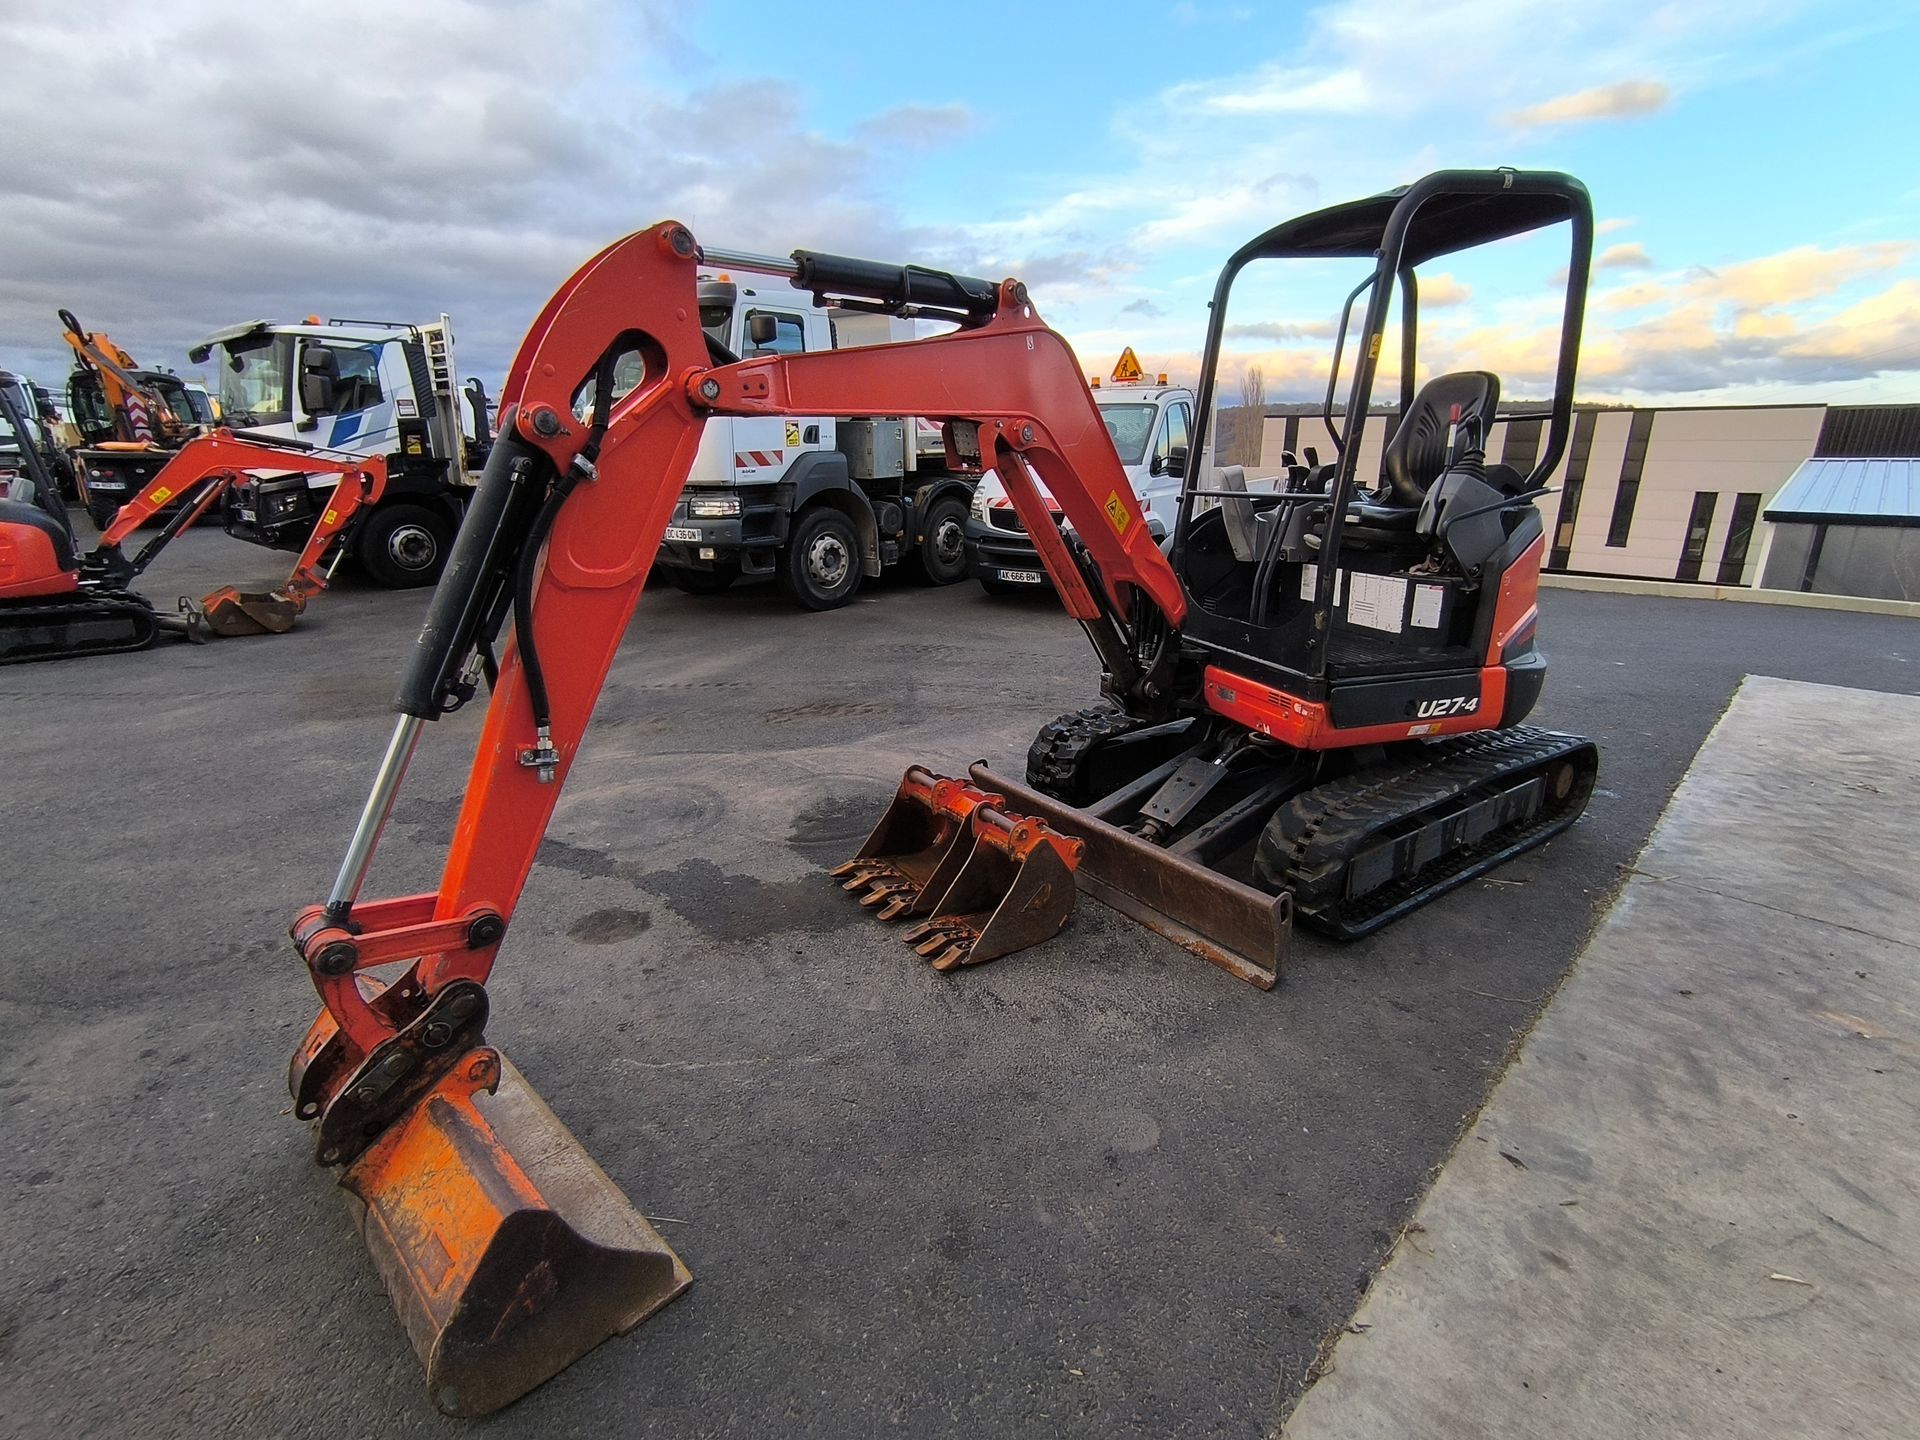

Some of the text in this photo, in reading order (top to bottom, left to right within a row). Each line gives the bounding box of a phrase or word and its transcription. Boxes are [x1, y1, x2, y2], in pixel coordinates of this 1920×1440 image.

[676, 530, 687, 539] 436
[1011, 571, 1024, 580] 666
[1417, 696, 1479, 718] U27-4
